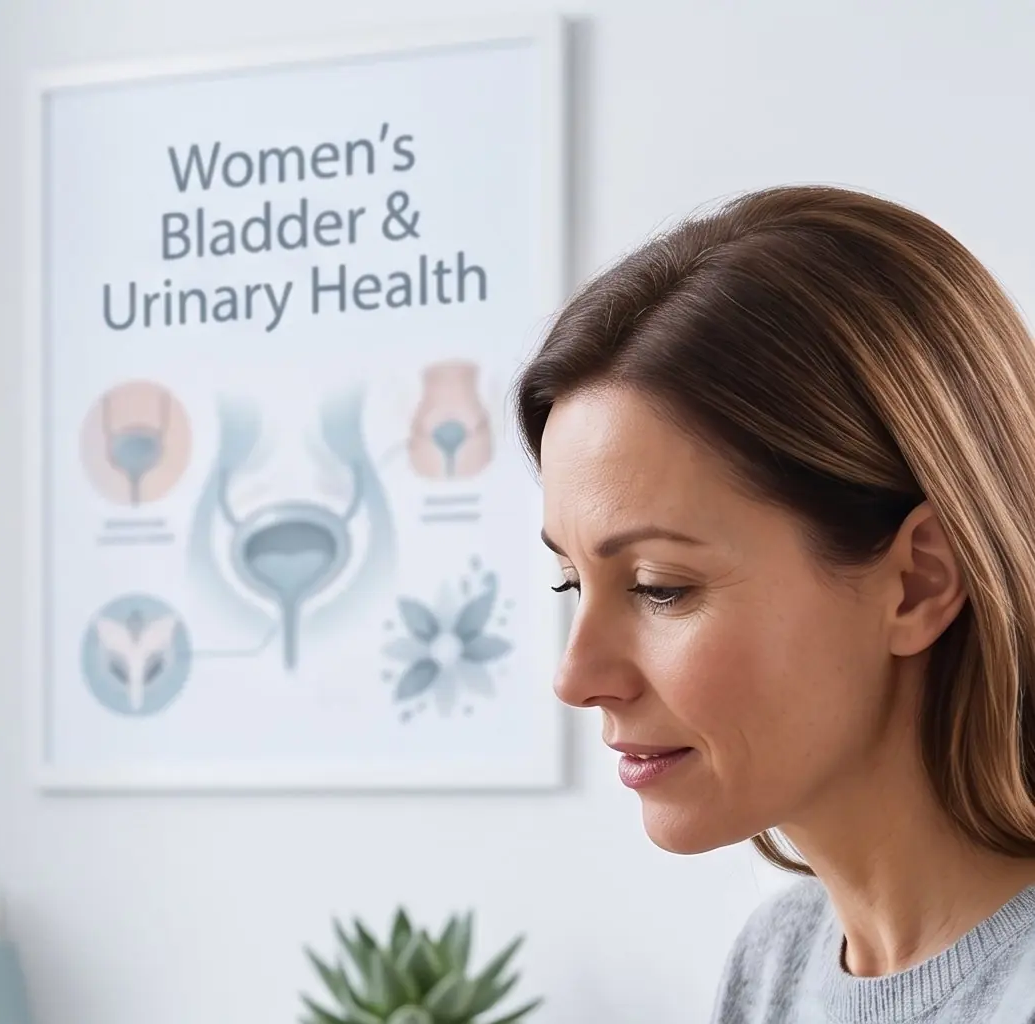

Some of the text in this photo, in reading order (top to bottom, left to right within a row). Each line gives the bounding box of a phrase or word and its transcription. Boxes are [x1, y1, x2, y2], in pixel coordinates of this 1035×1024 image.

[167, 122, 416, 193] Women's
[161, 190, 421, 261] Bladder &
[102, 251, 488, 333] Urinary Health
